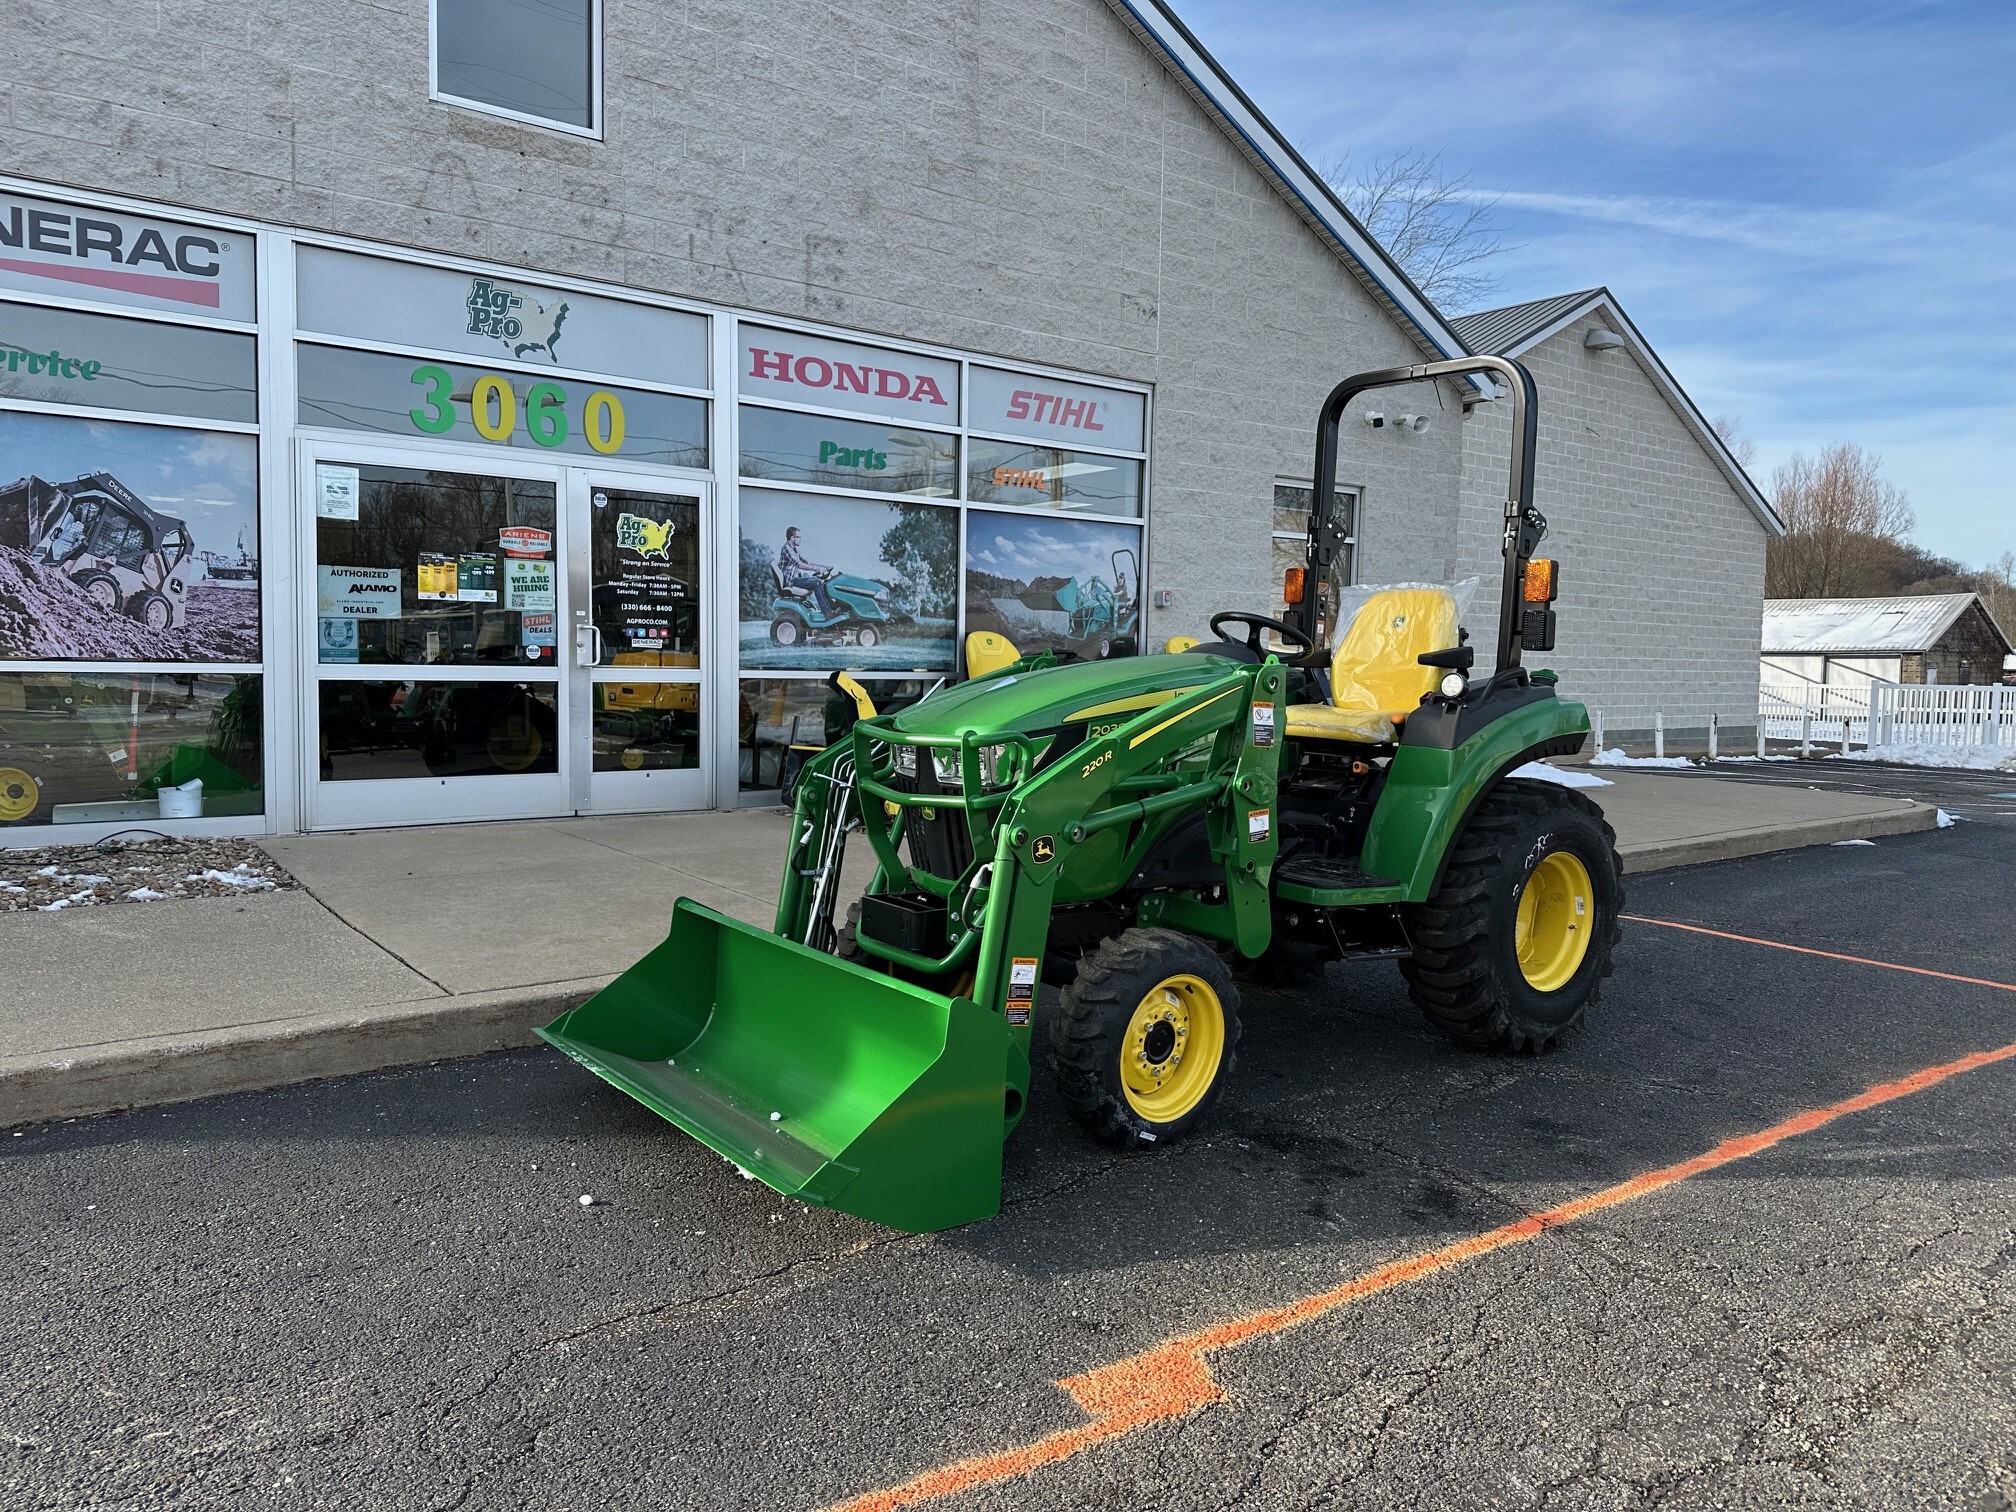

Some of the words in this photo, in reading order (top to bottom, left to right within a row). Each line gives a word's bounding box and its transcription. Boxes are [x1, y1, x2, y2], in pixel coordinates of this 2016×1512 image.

[467, 279, 522, 315] Ag-
[467, 306, 522, 339] Pro
[748, 347, 948, 406] HONDA
[409, 365, 625, 455] 3060
[1006, 390, 1105, 431] STIHL
[819, 440, 888, 471] Parts
[991, 466, 1048, 491] STIHL
[108, 480, 133, 503] DEERE
[620, 516, 647, 534] Ag-
[504, 531, 545, 539] ARIENS
[620, 531, 647, 546] Pro
[331, 569, 389, 579] AUTHORIZED
[511, 576, 528, 584] WE
[530, 576, 550, 584] ARE
[348, 584, 398, 594] ALAMO
[513, 584, 549, 592] HIRING
[343, 606, 378, 614] DEALER
[524, 616, 551, 626] STIHL
